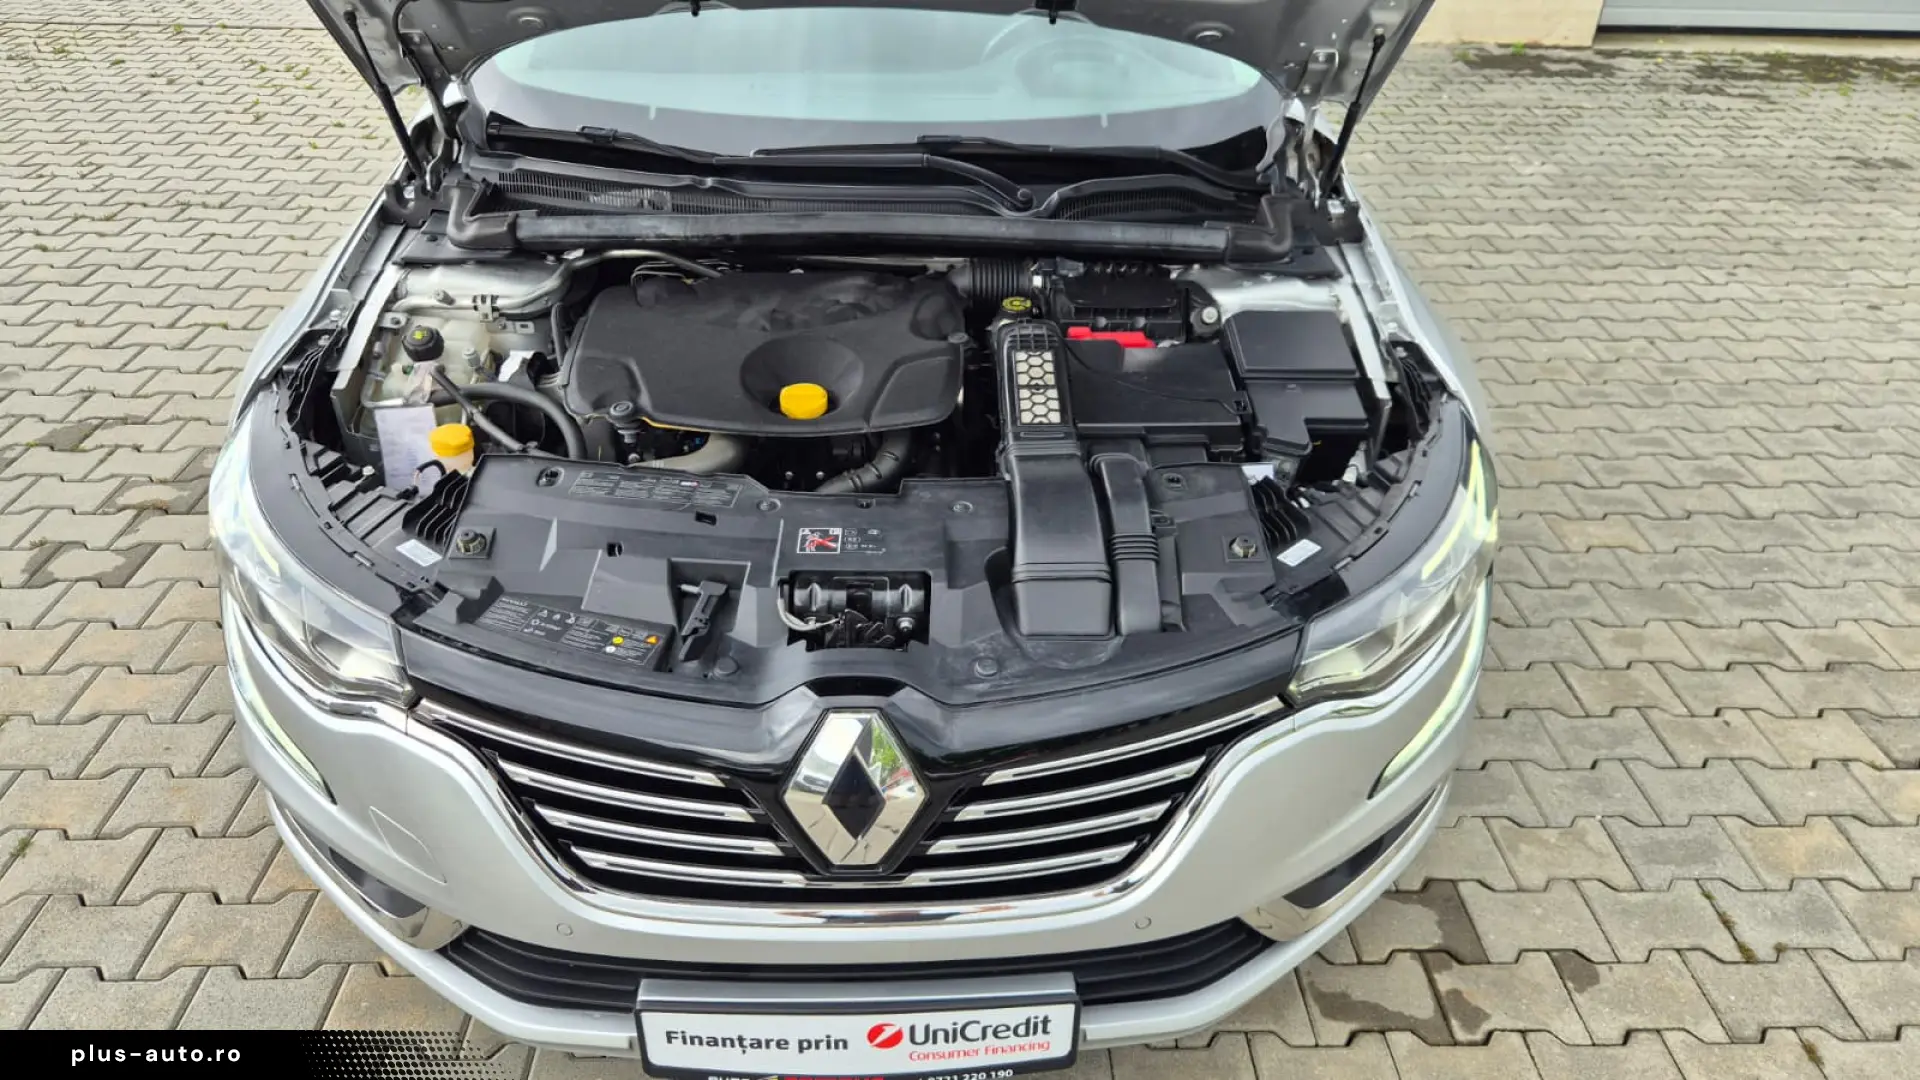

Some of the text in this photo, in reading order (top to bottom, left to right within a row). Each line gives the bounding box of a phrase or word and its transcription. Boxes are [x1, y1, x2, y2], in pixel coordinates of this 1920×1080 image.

[908, 1014, 1052, 1046] UniCredit
[665, 1030, 849, 1055] Finanțare prin
[908, 1040, 1051, 1062] Consumer Financing
[989, 1068, 1014, 1079] 190
